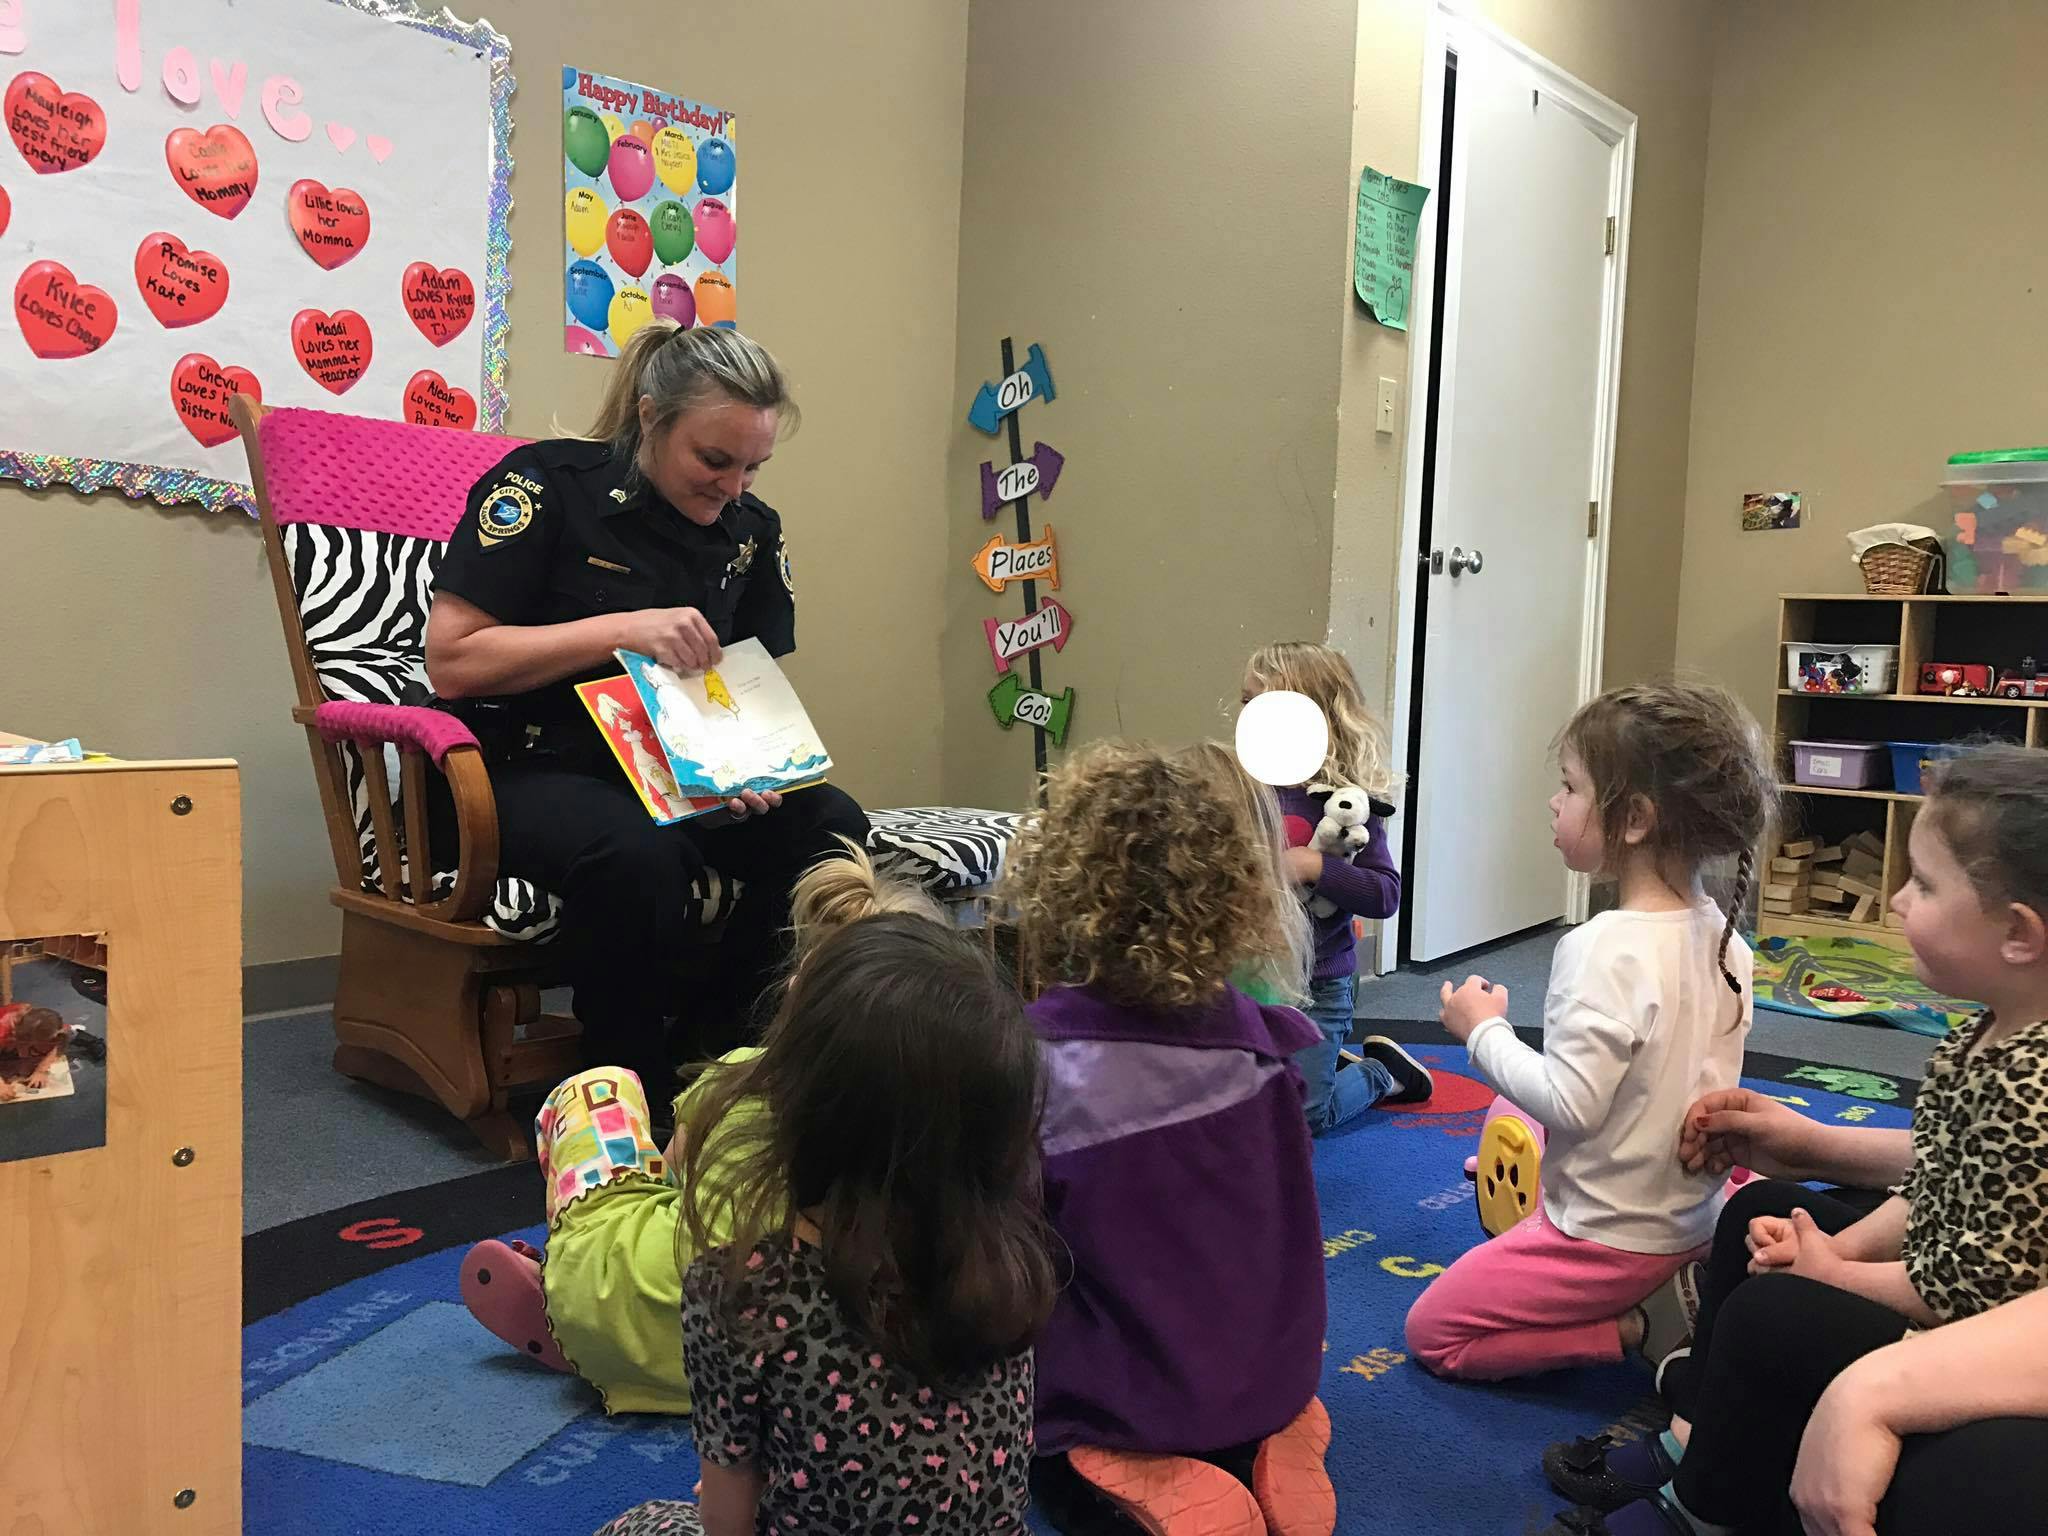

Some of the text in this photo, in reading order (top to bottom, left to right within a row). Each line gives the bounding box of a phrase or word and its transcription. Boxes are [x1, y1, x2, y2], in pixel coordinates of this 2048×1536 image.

[578, 72, 723, 137] Happy Birthday!
[570, 108, 598, 124] January
[11, 117, 47, 143] Best
[664, 130, 685, 142] March
[616, 139, 648, 155] February
[195, 182, 252, 201] Mommy
[578, 191, 593, 204] May
[702, 199, 724, 211] August
[317, 212, 340, 228] her
[621, 212, 636, 222] June
[303, 227, 354, 248] Momma
[160, 241, 218, 284] Promise
[162, 264, 201, 293] Loves
[421, 271, 461, 291] Adam
[570, 266, 609, 281] September
[656, 280, 691, 292] November
[700, 276, 732, 289] December
[146, 276, 187, 307] Kate
[407, 288, 443, 303] Loves
[621, 290, 648, 303] October
[413, 305, 467, 321] and Miss
[315, 321, 347, 336] Maddi
[300, 338, 360, 354] Loves her
[306, 355, 348, 371] Momma
[199, 365, 239, 393] Chevy
[178, 377, 217, 400] Loves
[1001, 374, 1030, 407] Oh
[181, 397, 217, 421] Sister
[410, 391, 464, 424] Loves her
[505, 471, 544, 495] POLICE
[1000, 467, 1038, 497] The
[519, 495, 529, 506] OF
[487, 521, 525, 534] SPRINGS
[991, 546, 1052, 577] Places
[998, 606, 1060, 656] You'll
